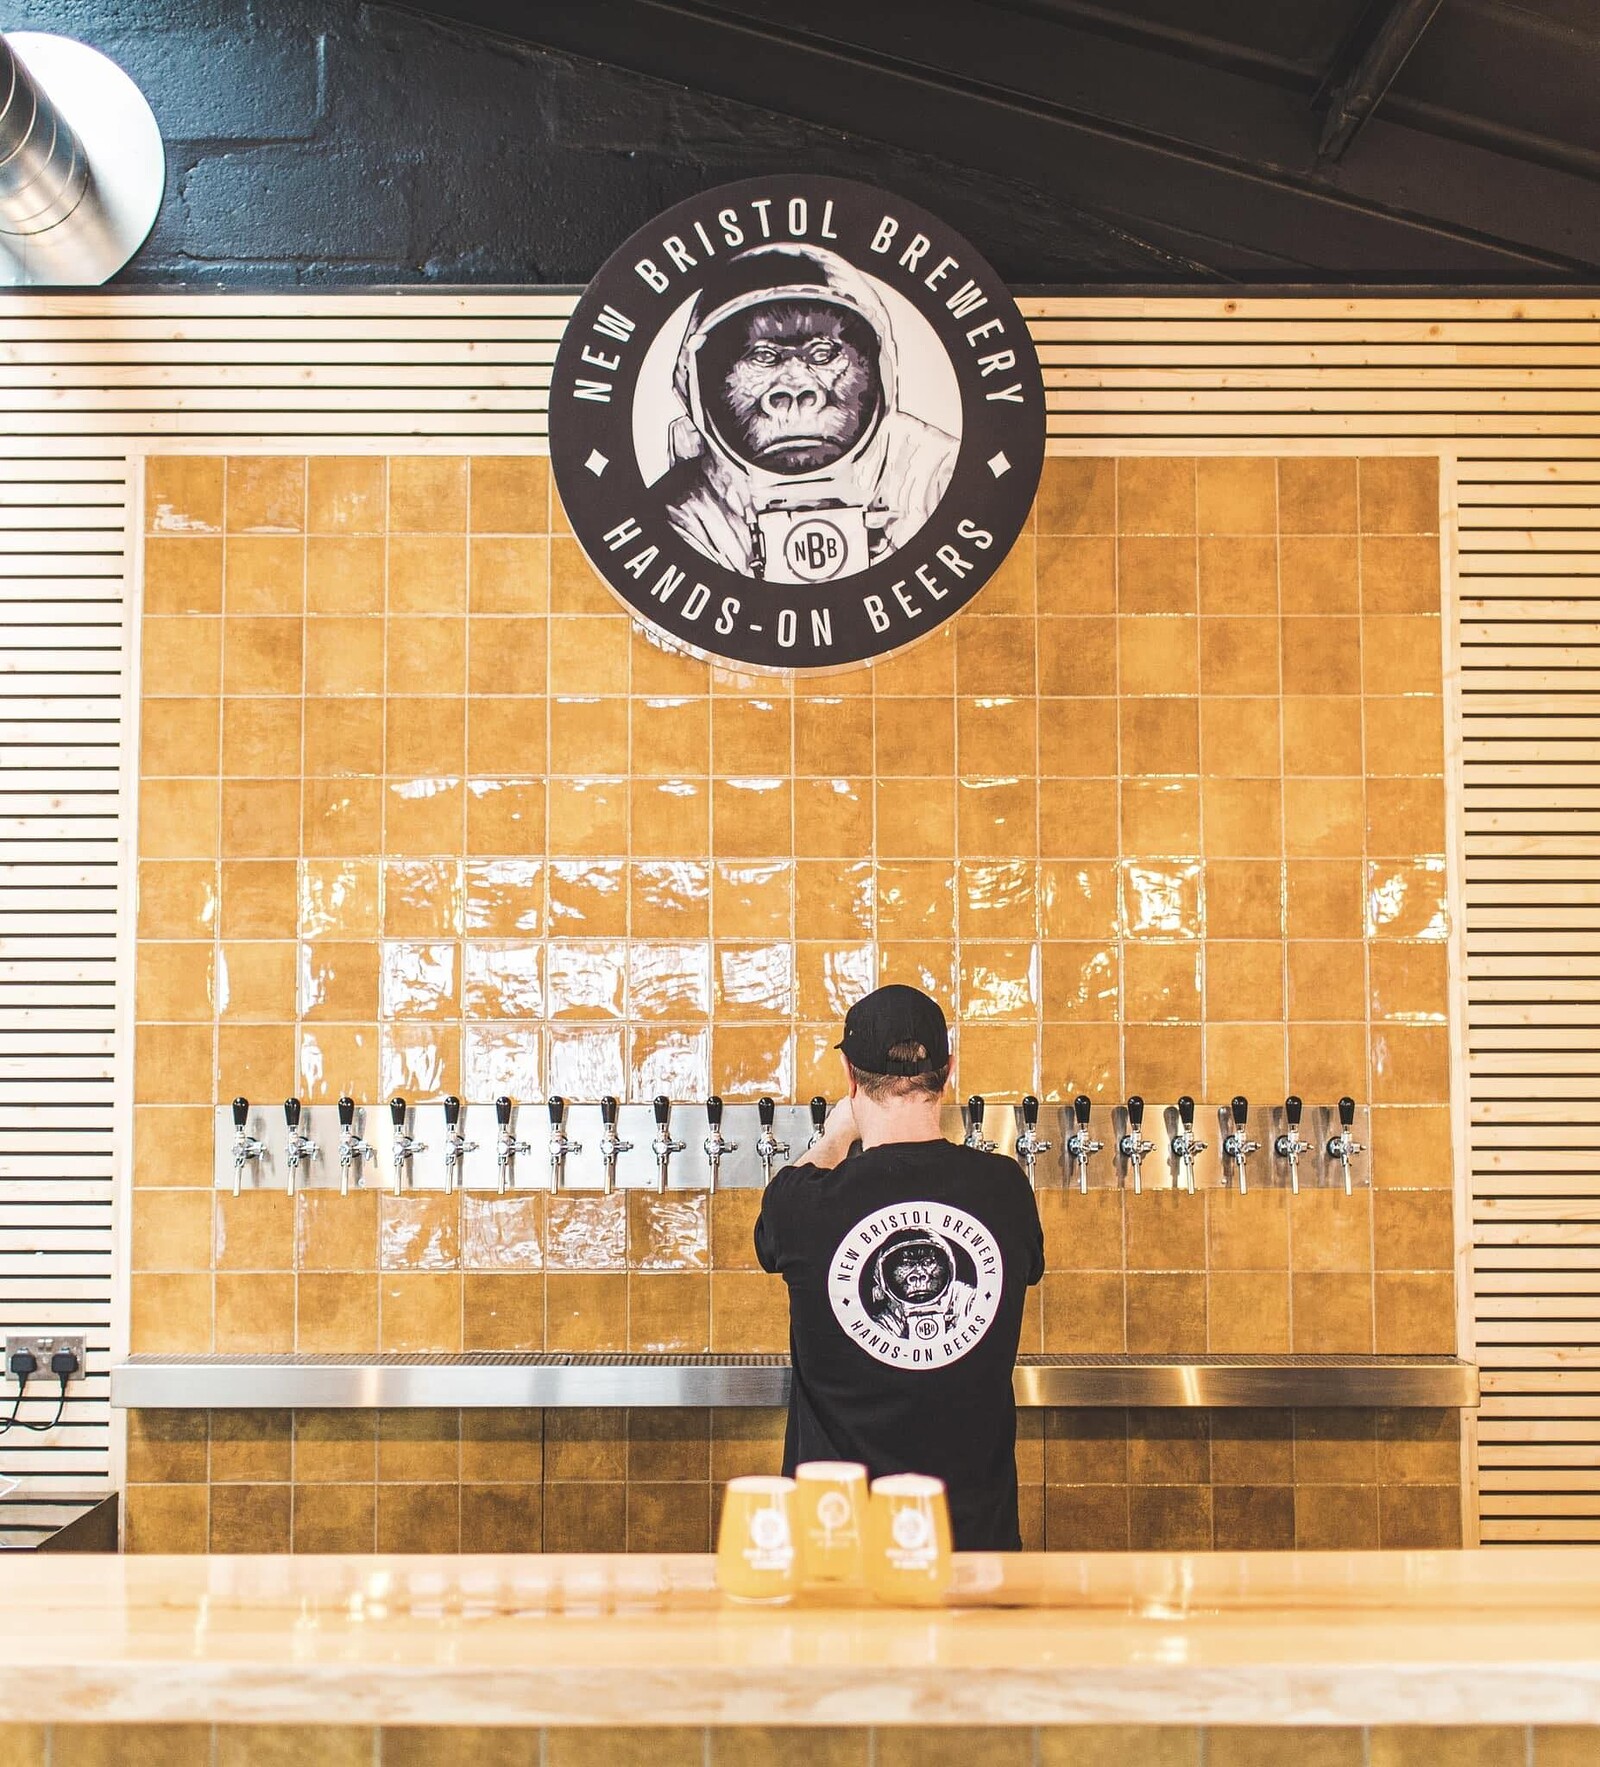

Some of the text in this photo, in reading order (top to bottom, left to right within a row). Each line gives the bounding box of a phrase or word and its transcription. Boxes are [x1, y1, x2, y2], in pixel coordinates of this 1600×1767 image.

[572, 198, 1025, 404] NEW BRISTOL BREWERY
[602, 516, 994, 648] HANDS-ON BEERS
[794, 531, 838, 570] NBB
[837, 1210, 996, 1282] NEW BRISTOL BREWERY
[850, 1314, 987, 1363] HANDS-ON BEERS
